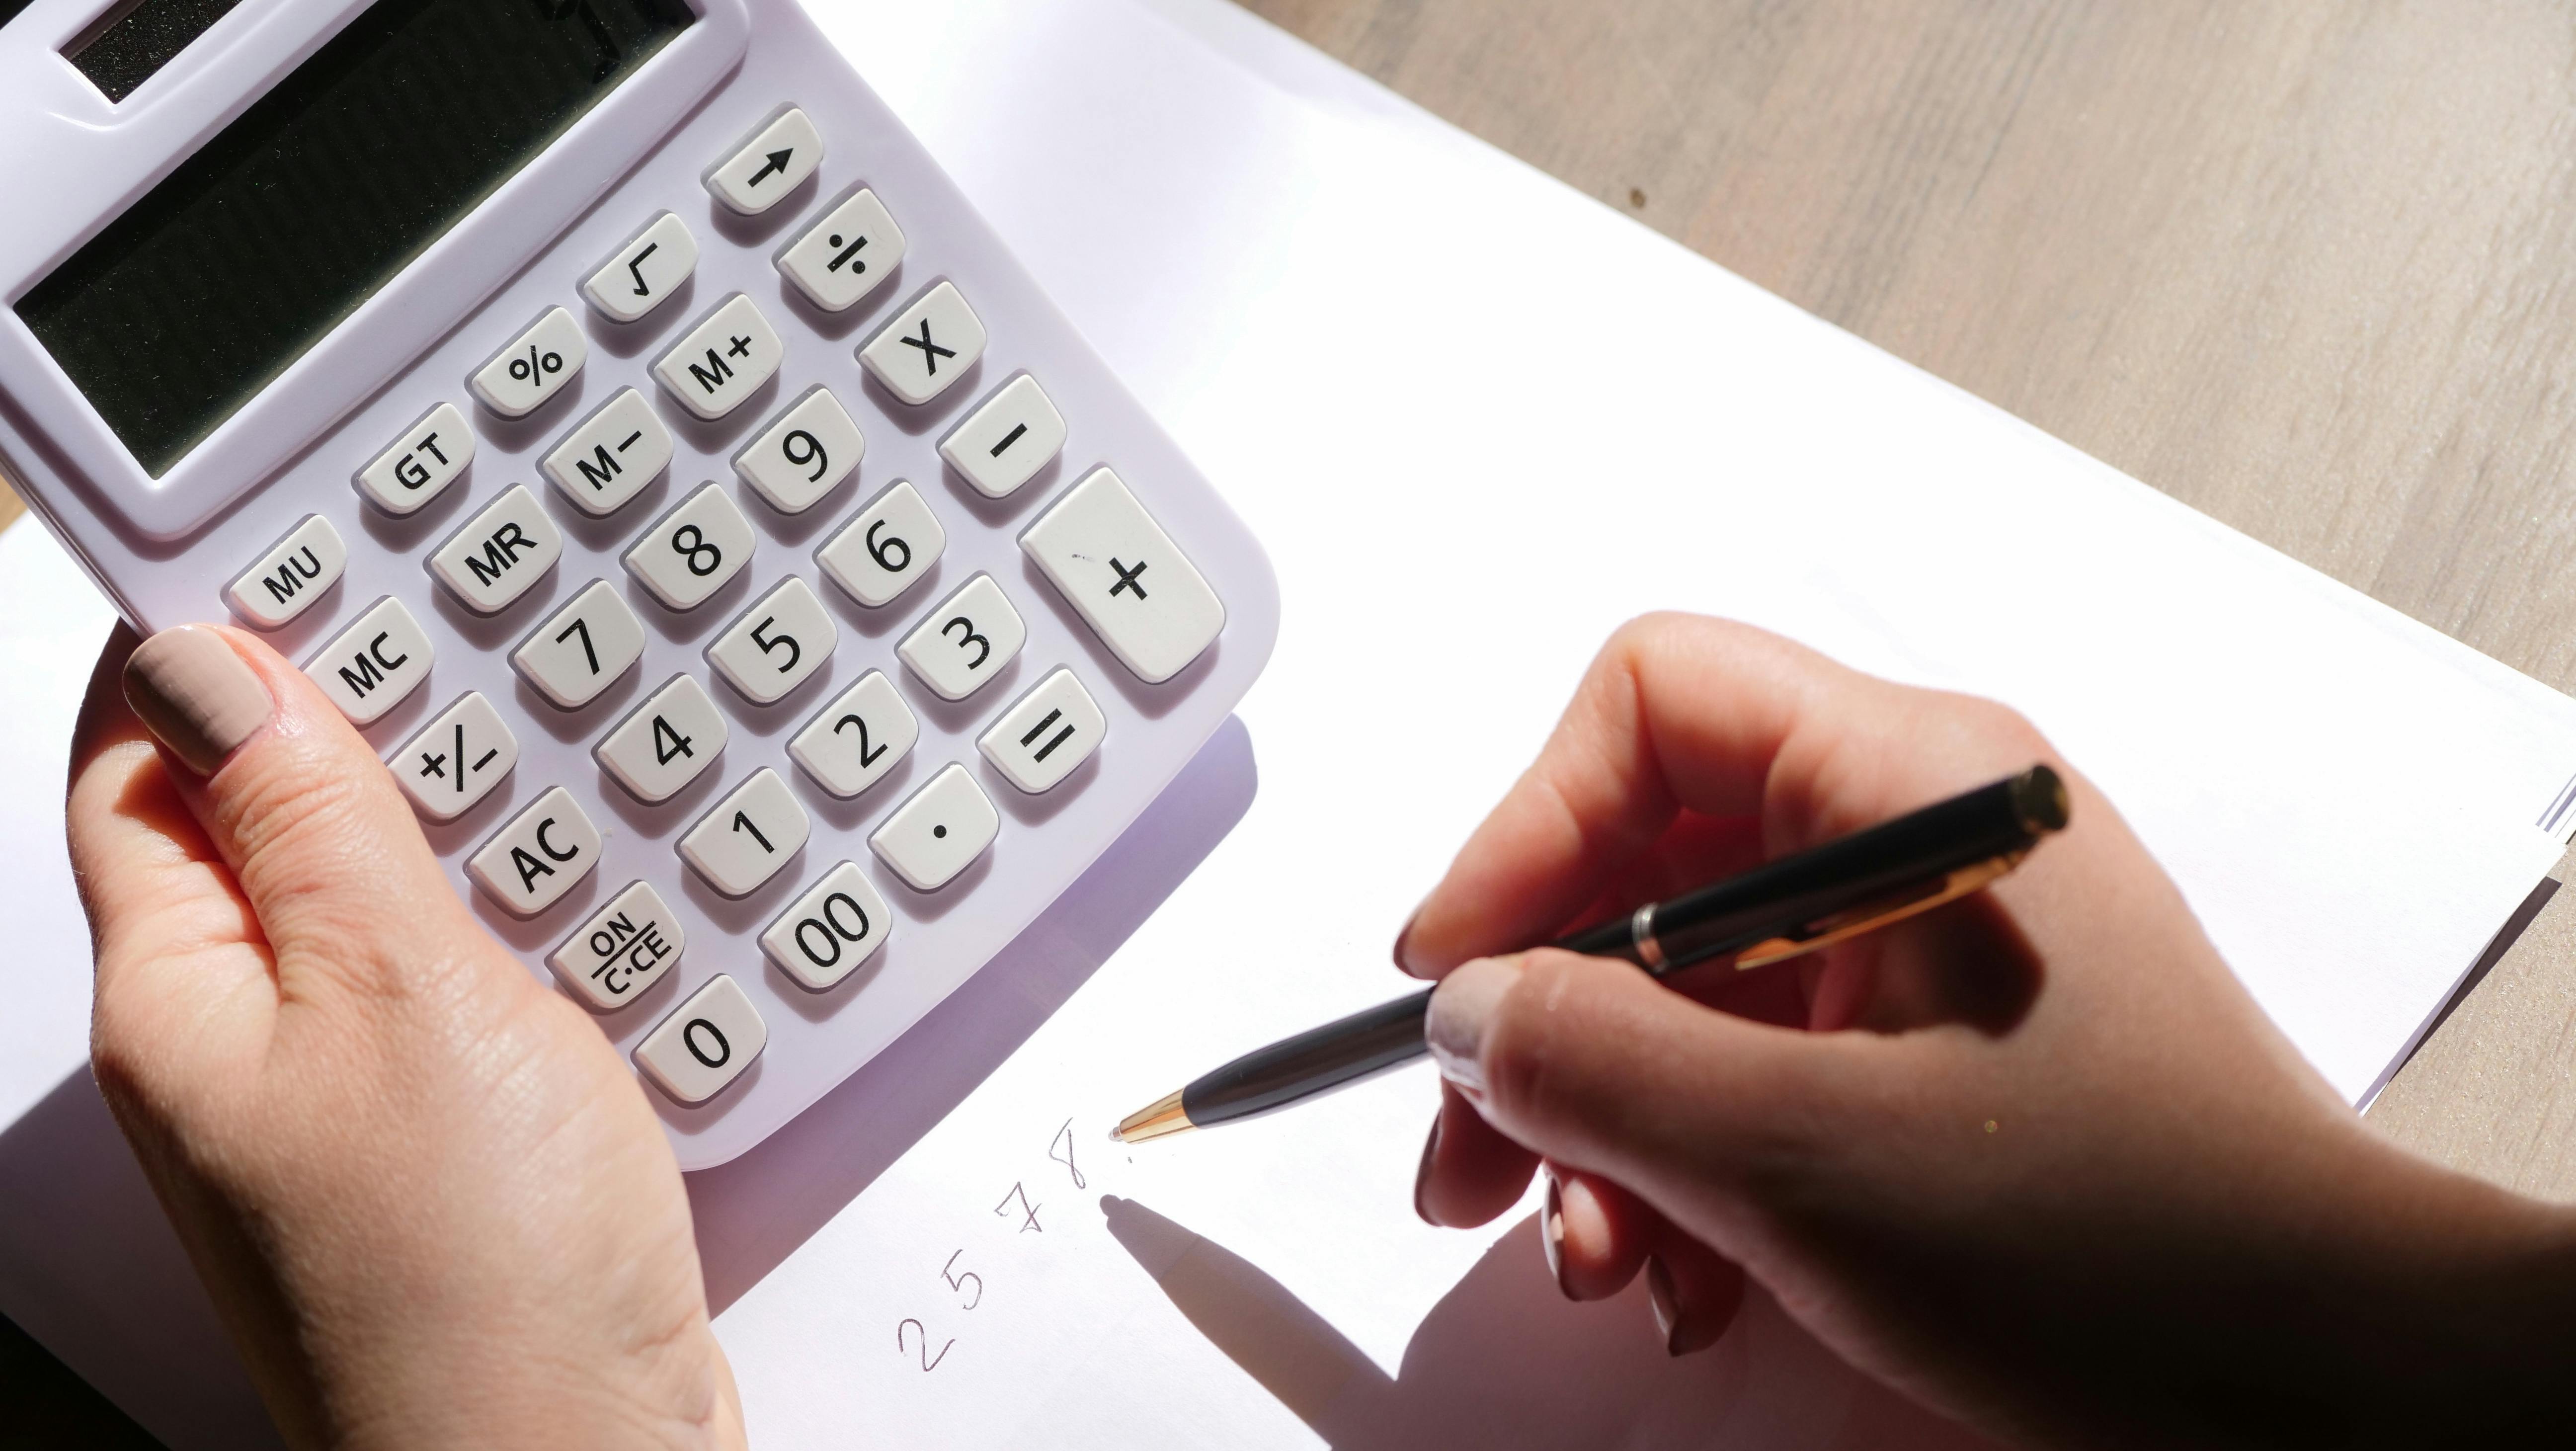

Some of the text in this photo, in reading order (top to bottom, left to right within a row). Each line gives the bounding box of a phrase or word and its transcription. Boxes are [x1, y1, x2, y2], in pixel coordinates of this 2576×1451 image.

[509, 345, 563, 387] %
[688, 335, 752, 394] M+
[395, 432, 449, 490] GT
[783, 430, 828, 483] 9
[464, 522, 538, 587] MR
[671, 524, 722, 576] 8
[866, 519, 911, 572] 6
[262, 546, 322, 605] MU
[338, 631, 408, 699] MC
[555, 618, 600, 676] 7
[749, 616, 801, 674] 5
[941, 617, 990, 670] 3
[652, 715, 694, 766] 4
[833, 714, 888, 769] 2
[1020, 708, 1076, 763] =
[510, 817, 579, 894] AC
[732, 810, 775, 854] 1
[590, 911, 637, 957] ON
[795, 892, 869, 967] 00
[683, 1018, 730, 1069] 0
